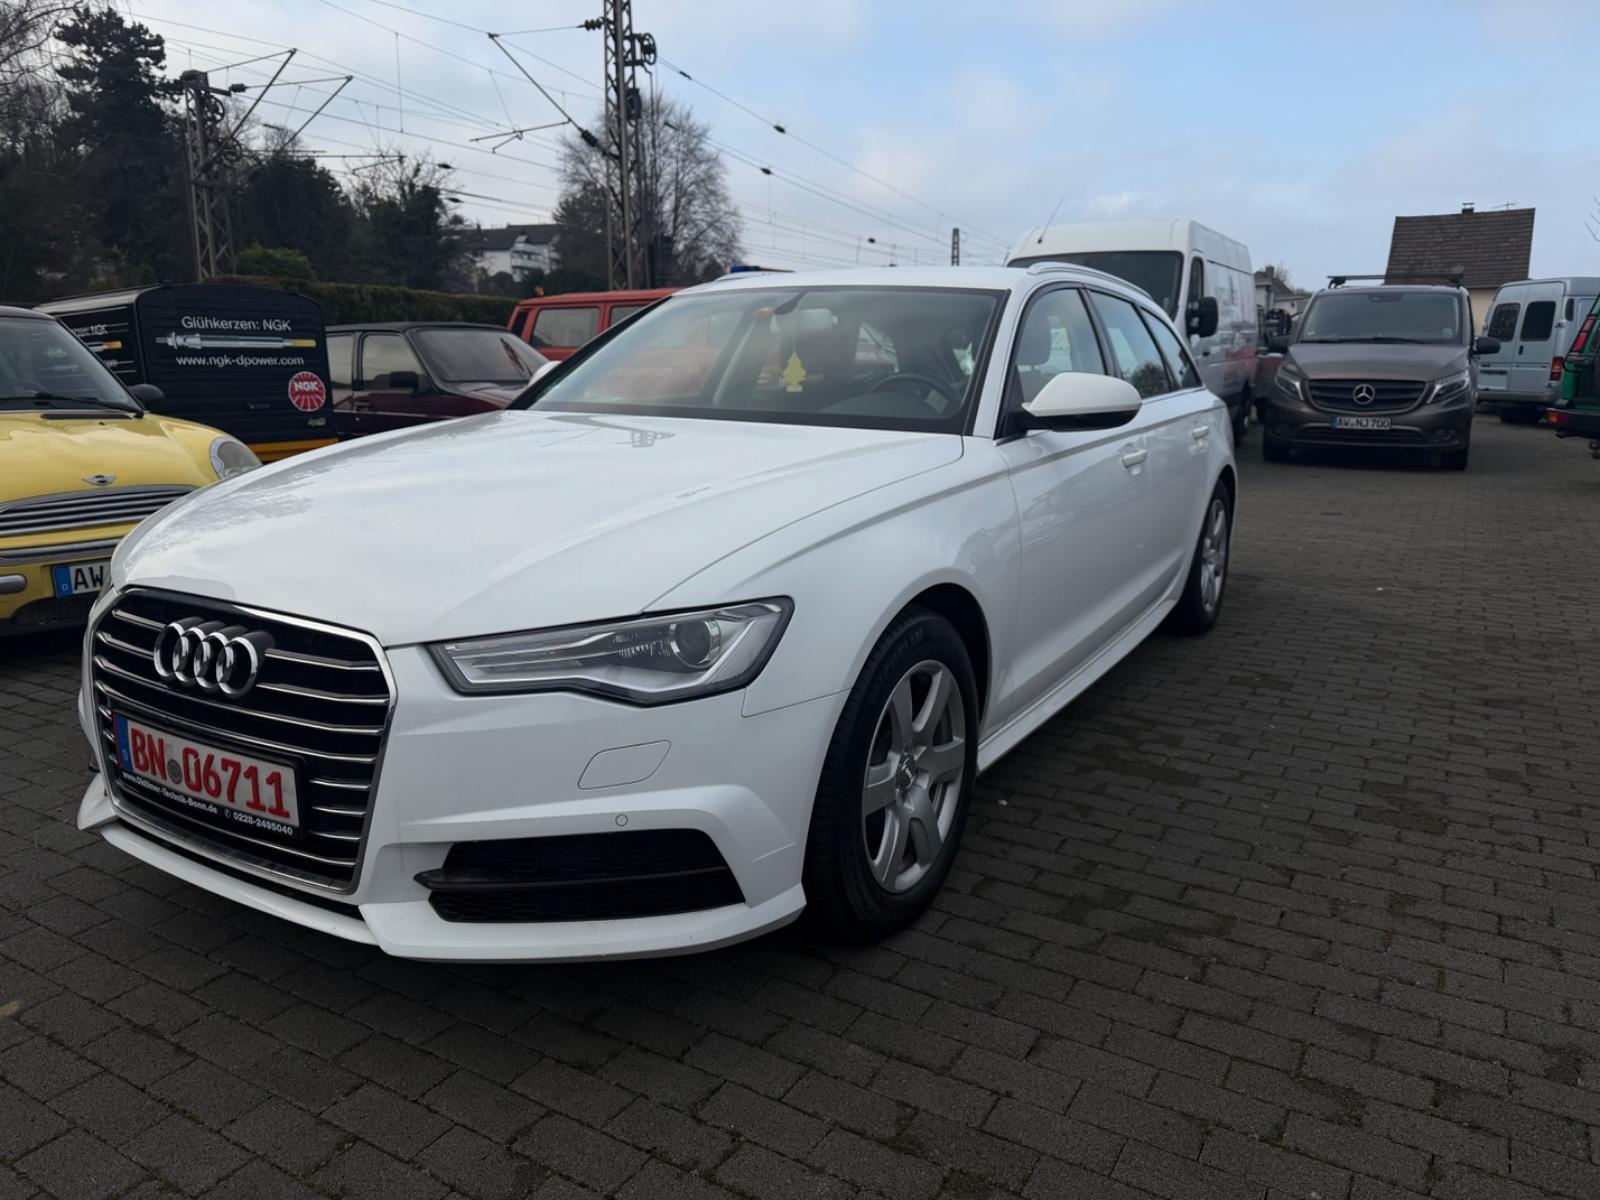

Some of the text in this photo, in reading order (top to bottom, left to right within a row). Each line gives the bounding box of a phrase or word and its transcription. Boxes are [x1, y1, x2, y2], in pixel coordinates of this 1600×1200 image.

[181, 315, 292, 331] Glühkerzen: NGK
[175, 355, 305, 368] www.ngk-dpower.com
[292, 380, 319, 392] NGK
[1337, 418, 1350, 427] AW
[74, 565, 104, 590] AW
[131, 727, 290, 819] BN 06711
[122, 770, 293, 836] www.Oldtimer-Technik-Bonn.de 0228-2495040
